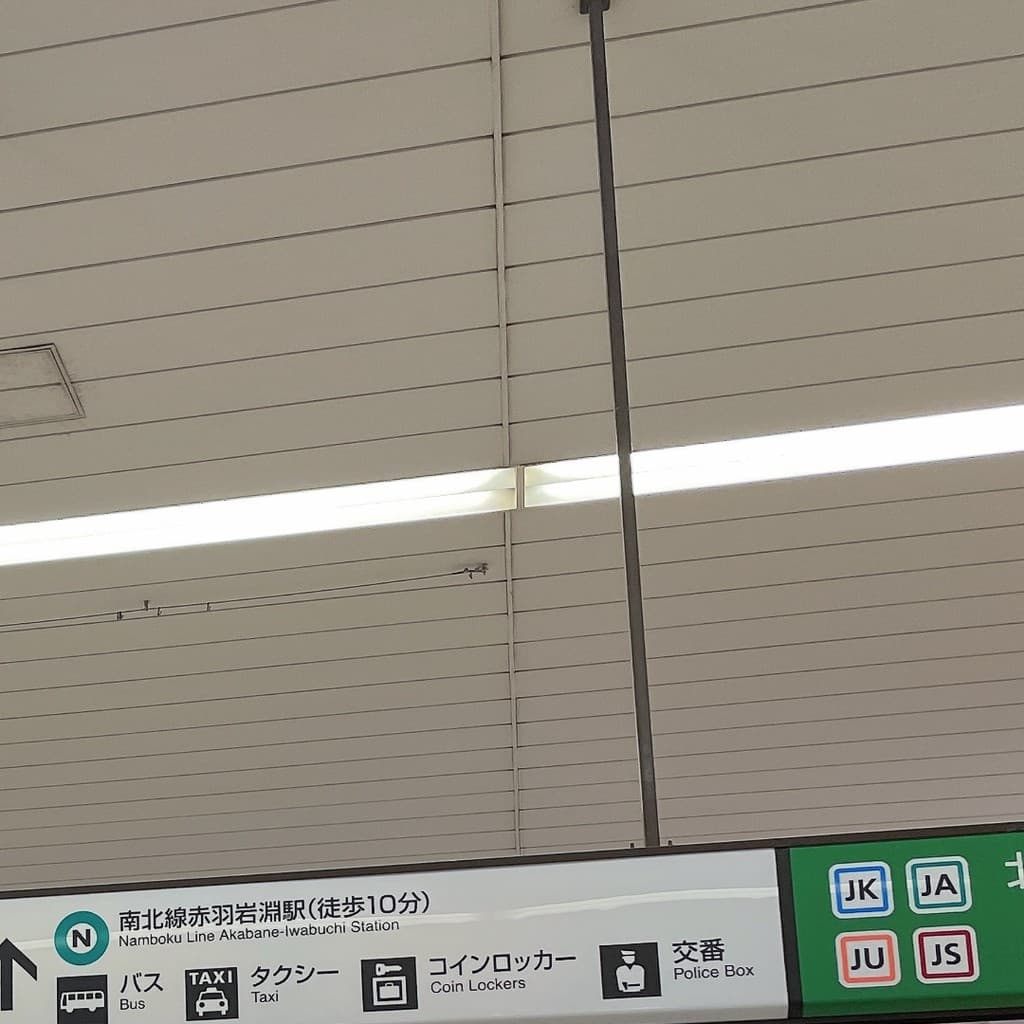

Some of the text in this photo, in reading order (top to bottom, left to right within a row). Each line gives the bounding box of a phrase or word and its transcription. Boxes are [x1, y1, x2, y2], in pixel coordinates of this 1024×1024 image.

[845, 878, 879, 901] JK
[921, 874, 958, 896] JA
[72, 929, 91, 948] N
[119, 919, 400, 946] Namboku Line Akabane-Iwabuchi Station
[672, 938, 725, 964] 交番
[851, 947, 885, 971] JU
[931, 943, 962, 966] JS
[429, 949, 577, 976] コインロッカー
[674, 964, 755, 980] Police Box
[120, 972, 164, 994] バス
[189, 970, 233, 985] TAXI
[251, 965, 339, 987] タクシー
[430, 978, 527, 993] Coin Lockers
[120, 998, 146, 1010] Bus
[251, 990, 279, 1003] Taxi
